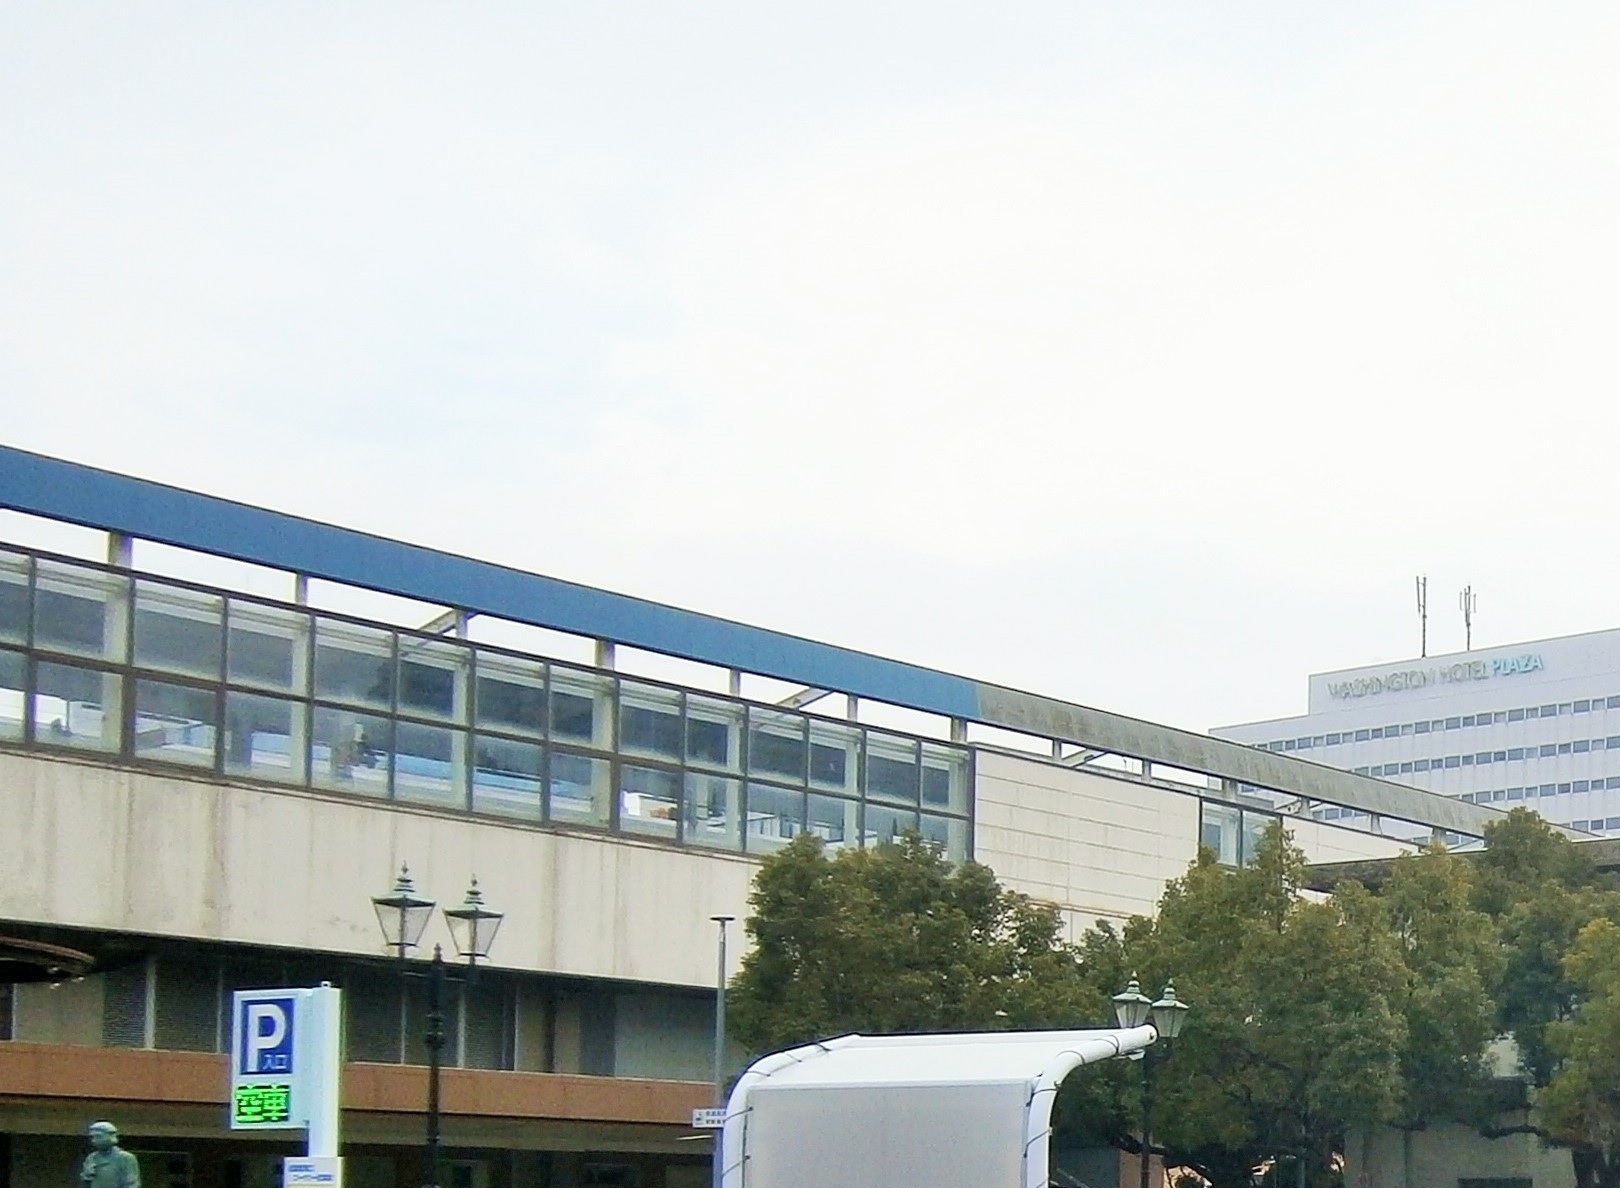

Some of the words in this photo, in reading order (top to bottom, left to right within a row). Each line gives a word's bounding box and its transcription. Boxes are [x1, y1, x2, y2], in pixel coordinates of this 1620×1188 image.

[1327, 668, 1434, 699] WASHINGTON
[1440, 660, 1489, 684] HOTEL
[1491, 654, 1543, 676] PLAZA
[247, 1003, 286, 1072] P
[262, 1054, 288, 1070] 入口
[236, 1085, 290, 1121] 空車
